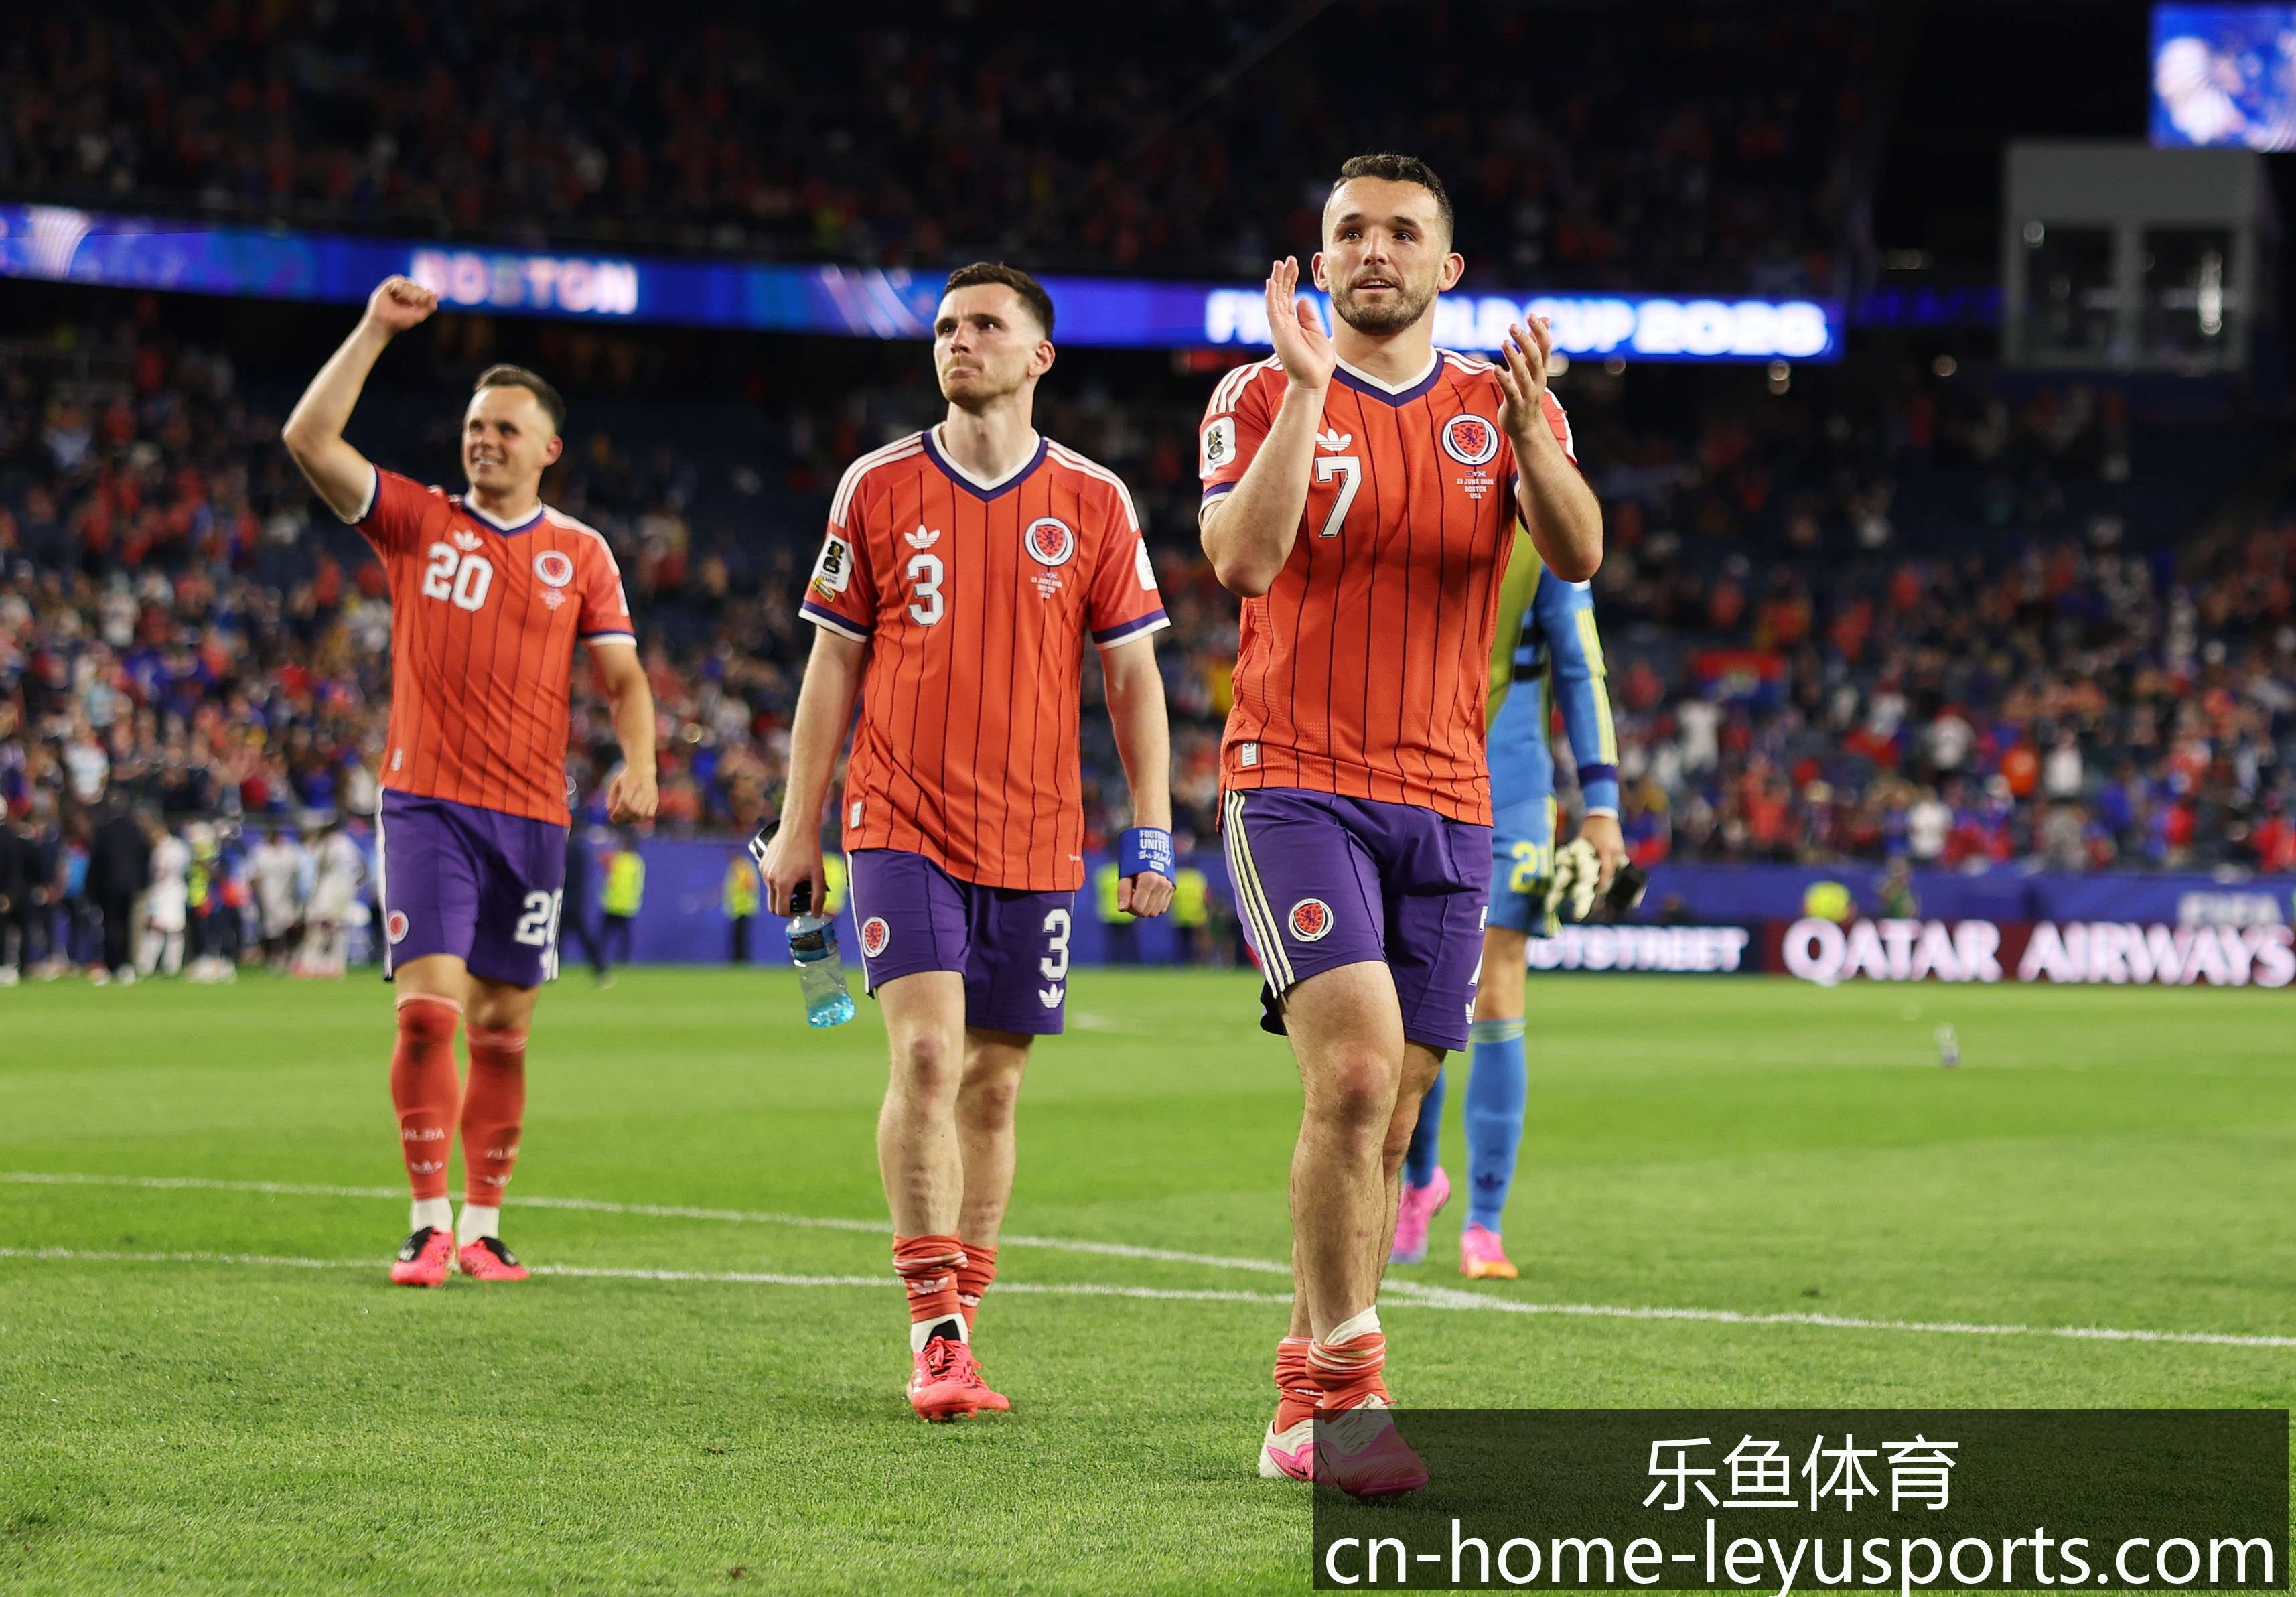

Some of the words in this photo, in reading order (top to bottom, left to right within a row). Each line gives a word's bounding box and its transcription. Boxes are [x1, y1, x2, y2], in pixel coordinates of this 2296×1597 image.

[1633, 299, 1829, 358] 2026
[1315, 456, 1362, 537] 7
[421, 541, 494, 612] 20
[907, 553, 944, 626] 3
[1039, 908, 1072, 981] 3
[1782, 916, 2004, 988] QATAR
[2017, 920, 2296, 988] AIRWAYS
